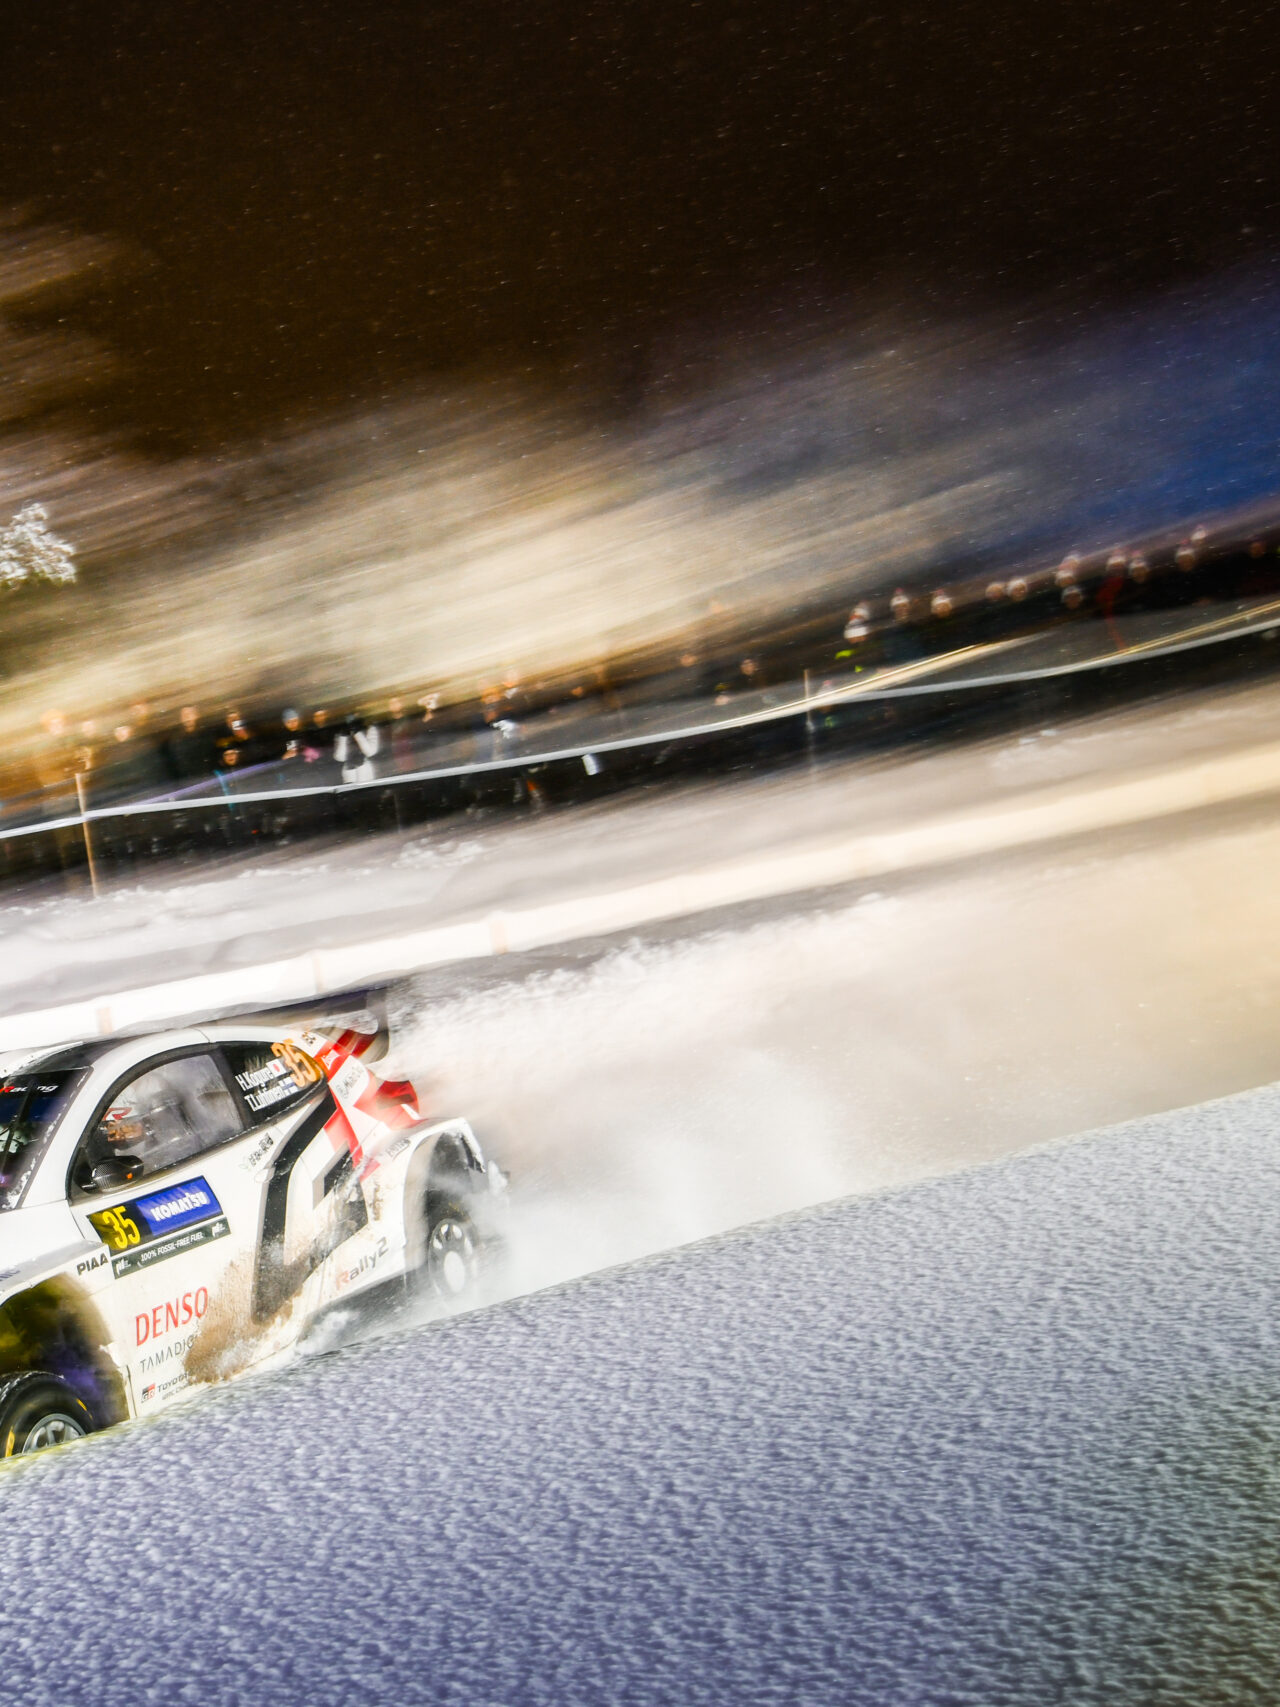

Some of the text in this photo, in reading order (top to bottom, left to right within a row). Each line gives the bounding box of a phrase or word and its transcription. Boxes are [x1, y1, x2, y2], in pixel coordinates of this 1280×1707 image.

[270, 1038, 318, 1087] 35
[102, 1190, 210, 1249] 35 KOMATSU
[76, 1253, 109, 1276] PIAA
[140, 1232, 204, 1262] 100% FOSSIL-FREE FUEL
[335, 1236, 389, 1291] Rally2
[135, 1286, 208, 1347] DENSO
